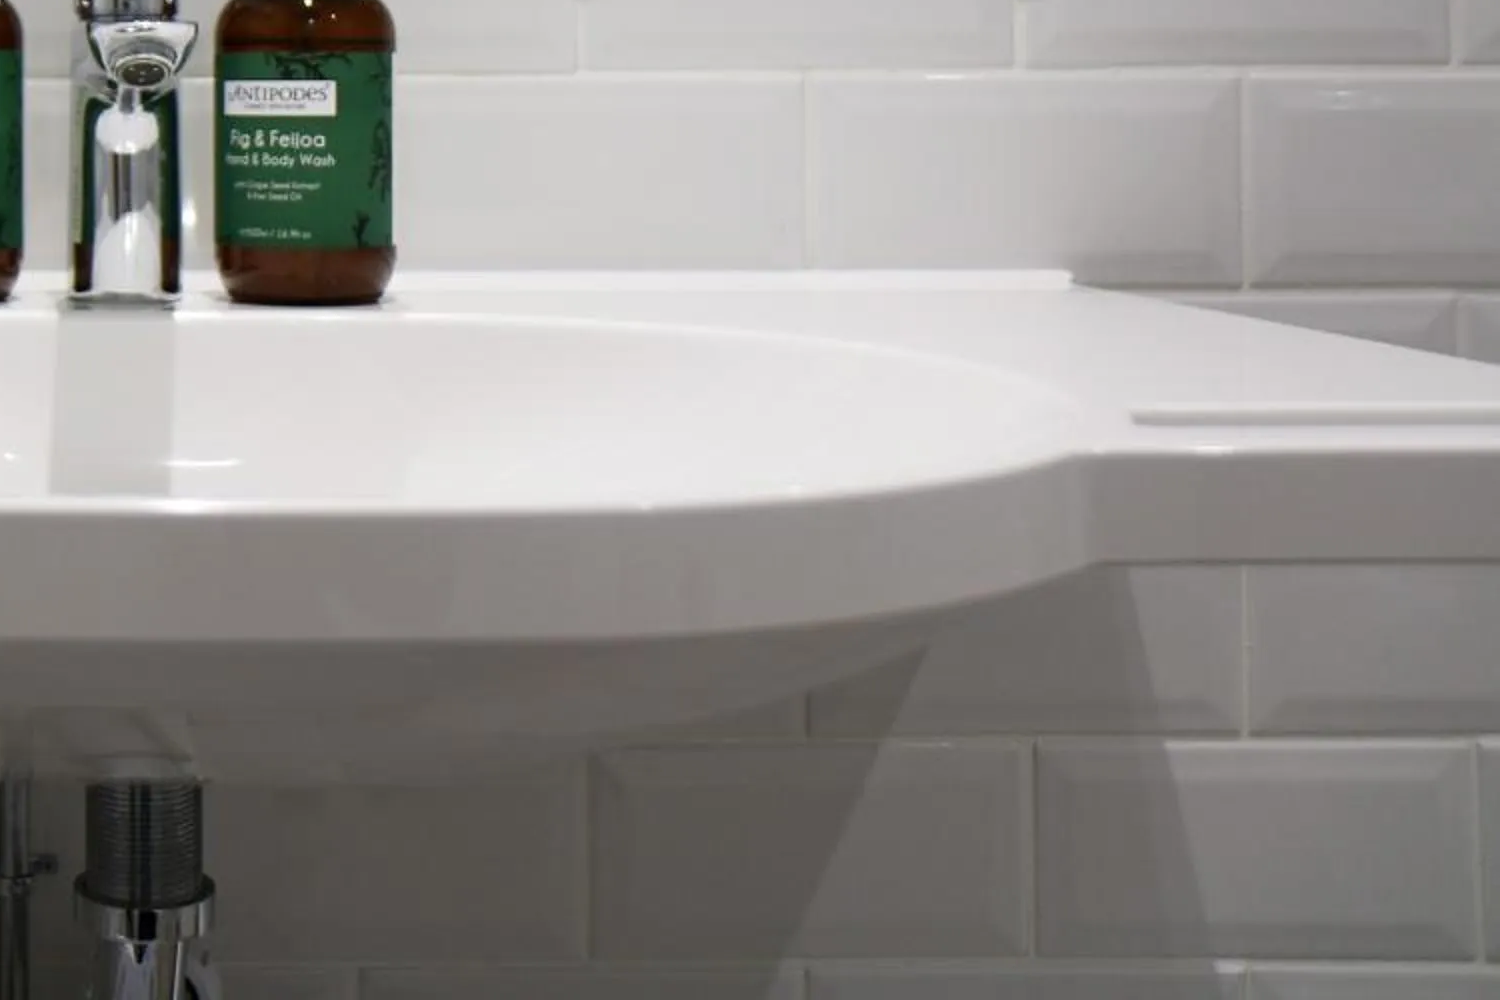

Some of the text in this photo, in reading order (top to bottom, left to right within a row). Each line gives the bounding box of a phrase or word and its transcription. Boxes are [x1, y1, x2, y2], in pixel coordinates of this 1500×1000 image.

[230, 128, 328, 150] Fig & Feijoa
[262, 151, 296, 169] Body
[299, 152, 337, 168] Wash
